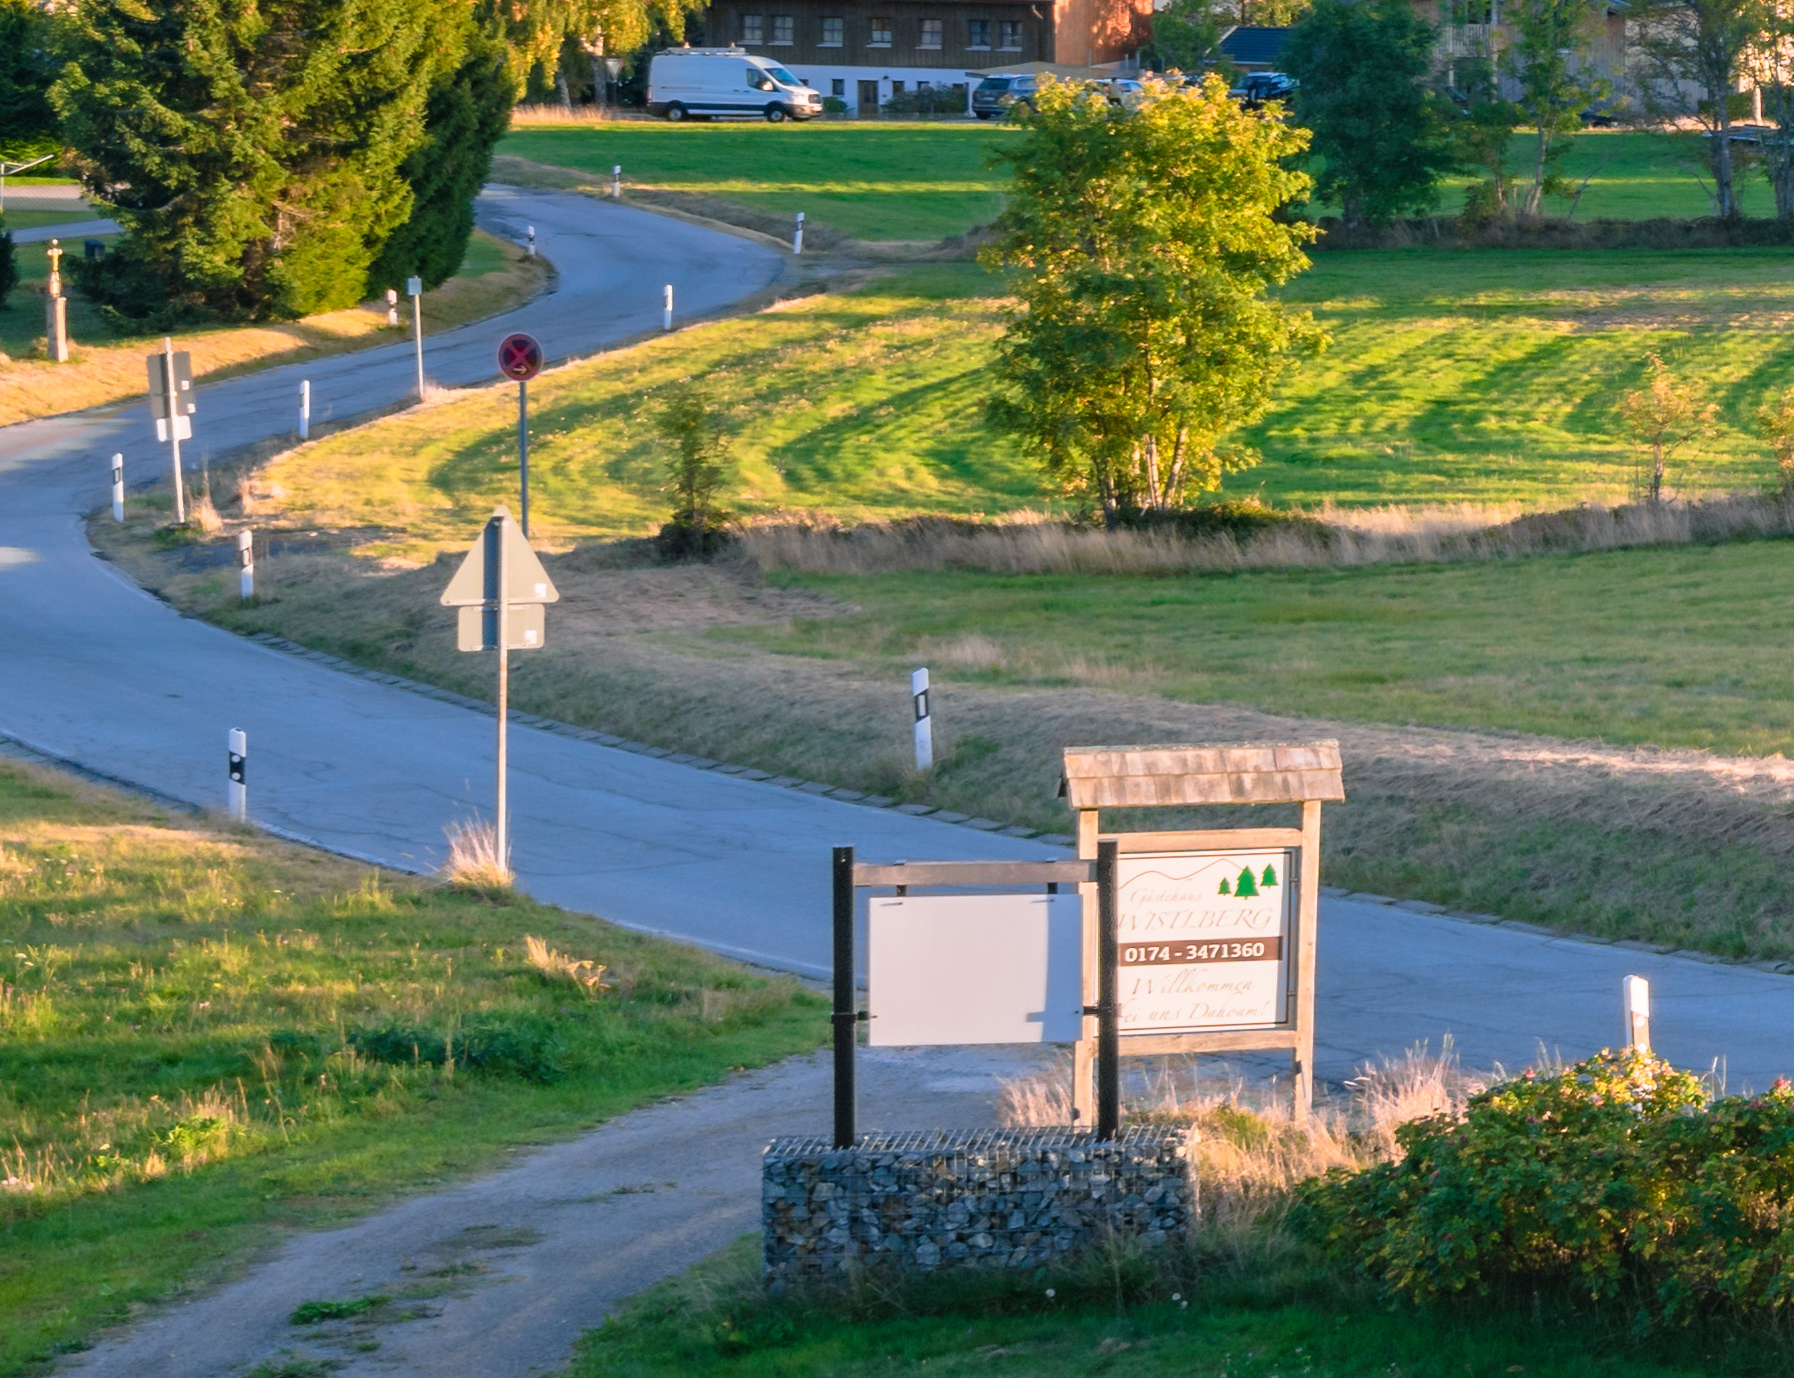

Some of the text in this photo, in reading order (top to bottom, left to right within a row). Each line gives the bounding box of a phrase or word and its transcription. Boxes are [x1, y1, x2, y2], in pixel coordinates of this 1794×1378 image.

[1124, 947, 1171, 963] 0174
[1186, 942, 1265, 960] 3471360
[1131, 968, 1254, 996] Willkommen
[1149, 1006, 1181, 1021] uns
